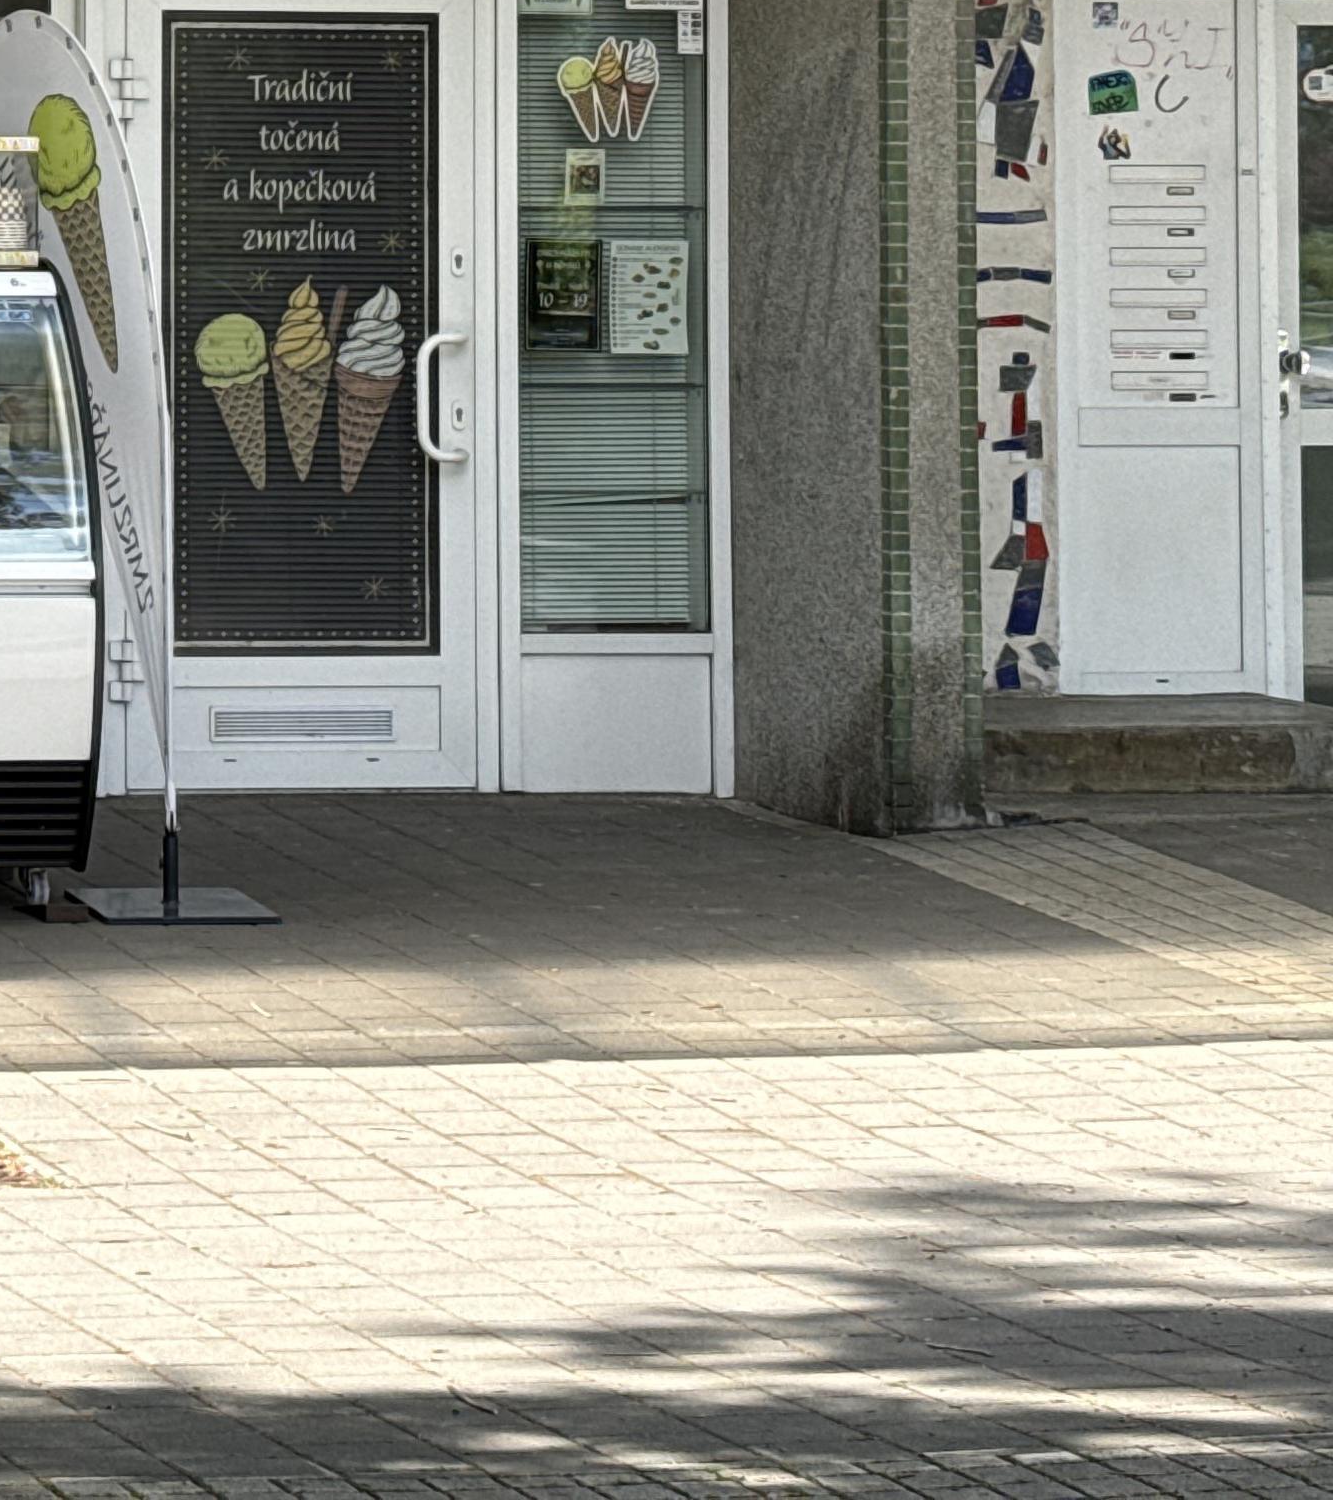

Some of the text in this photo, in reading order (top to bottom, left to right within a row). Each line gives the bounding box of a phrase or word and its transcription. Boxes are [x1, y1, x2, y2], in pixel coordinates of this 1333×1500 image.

[247, 70, 353, 103] Tradiční
[259, 121, 341, 152] točená
[223, 169, 377, 214] a kopečková
[242, 219, 357, 253] zmrzlina
